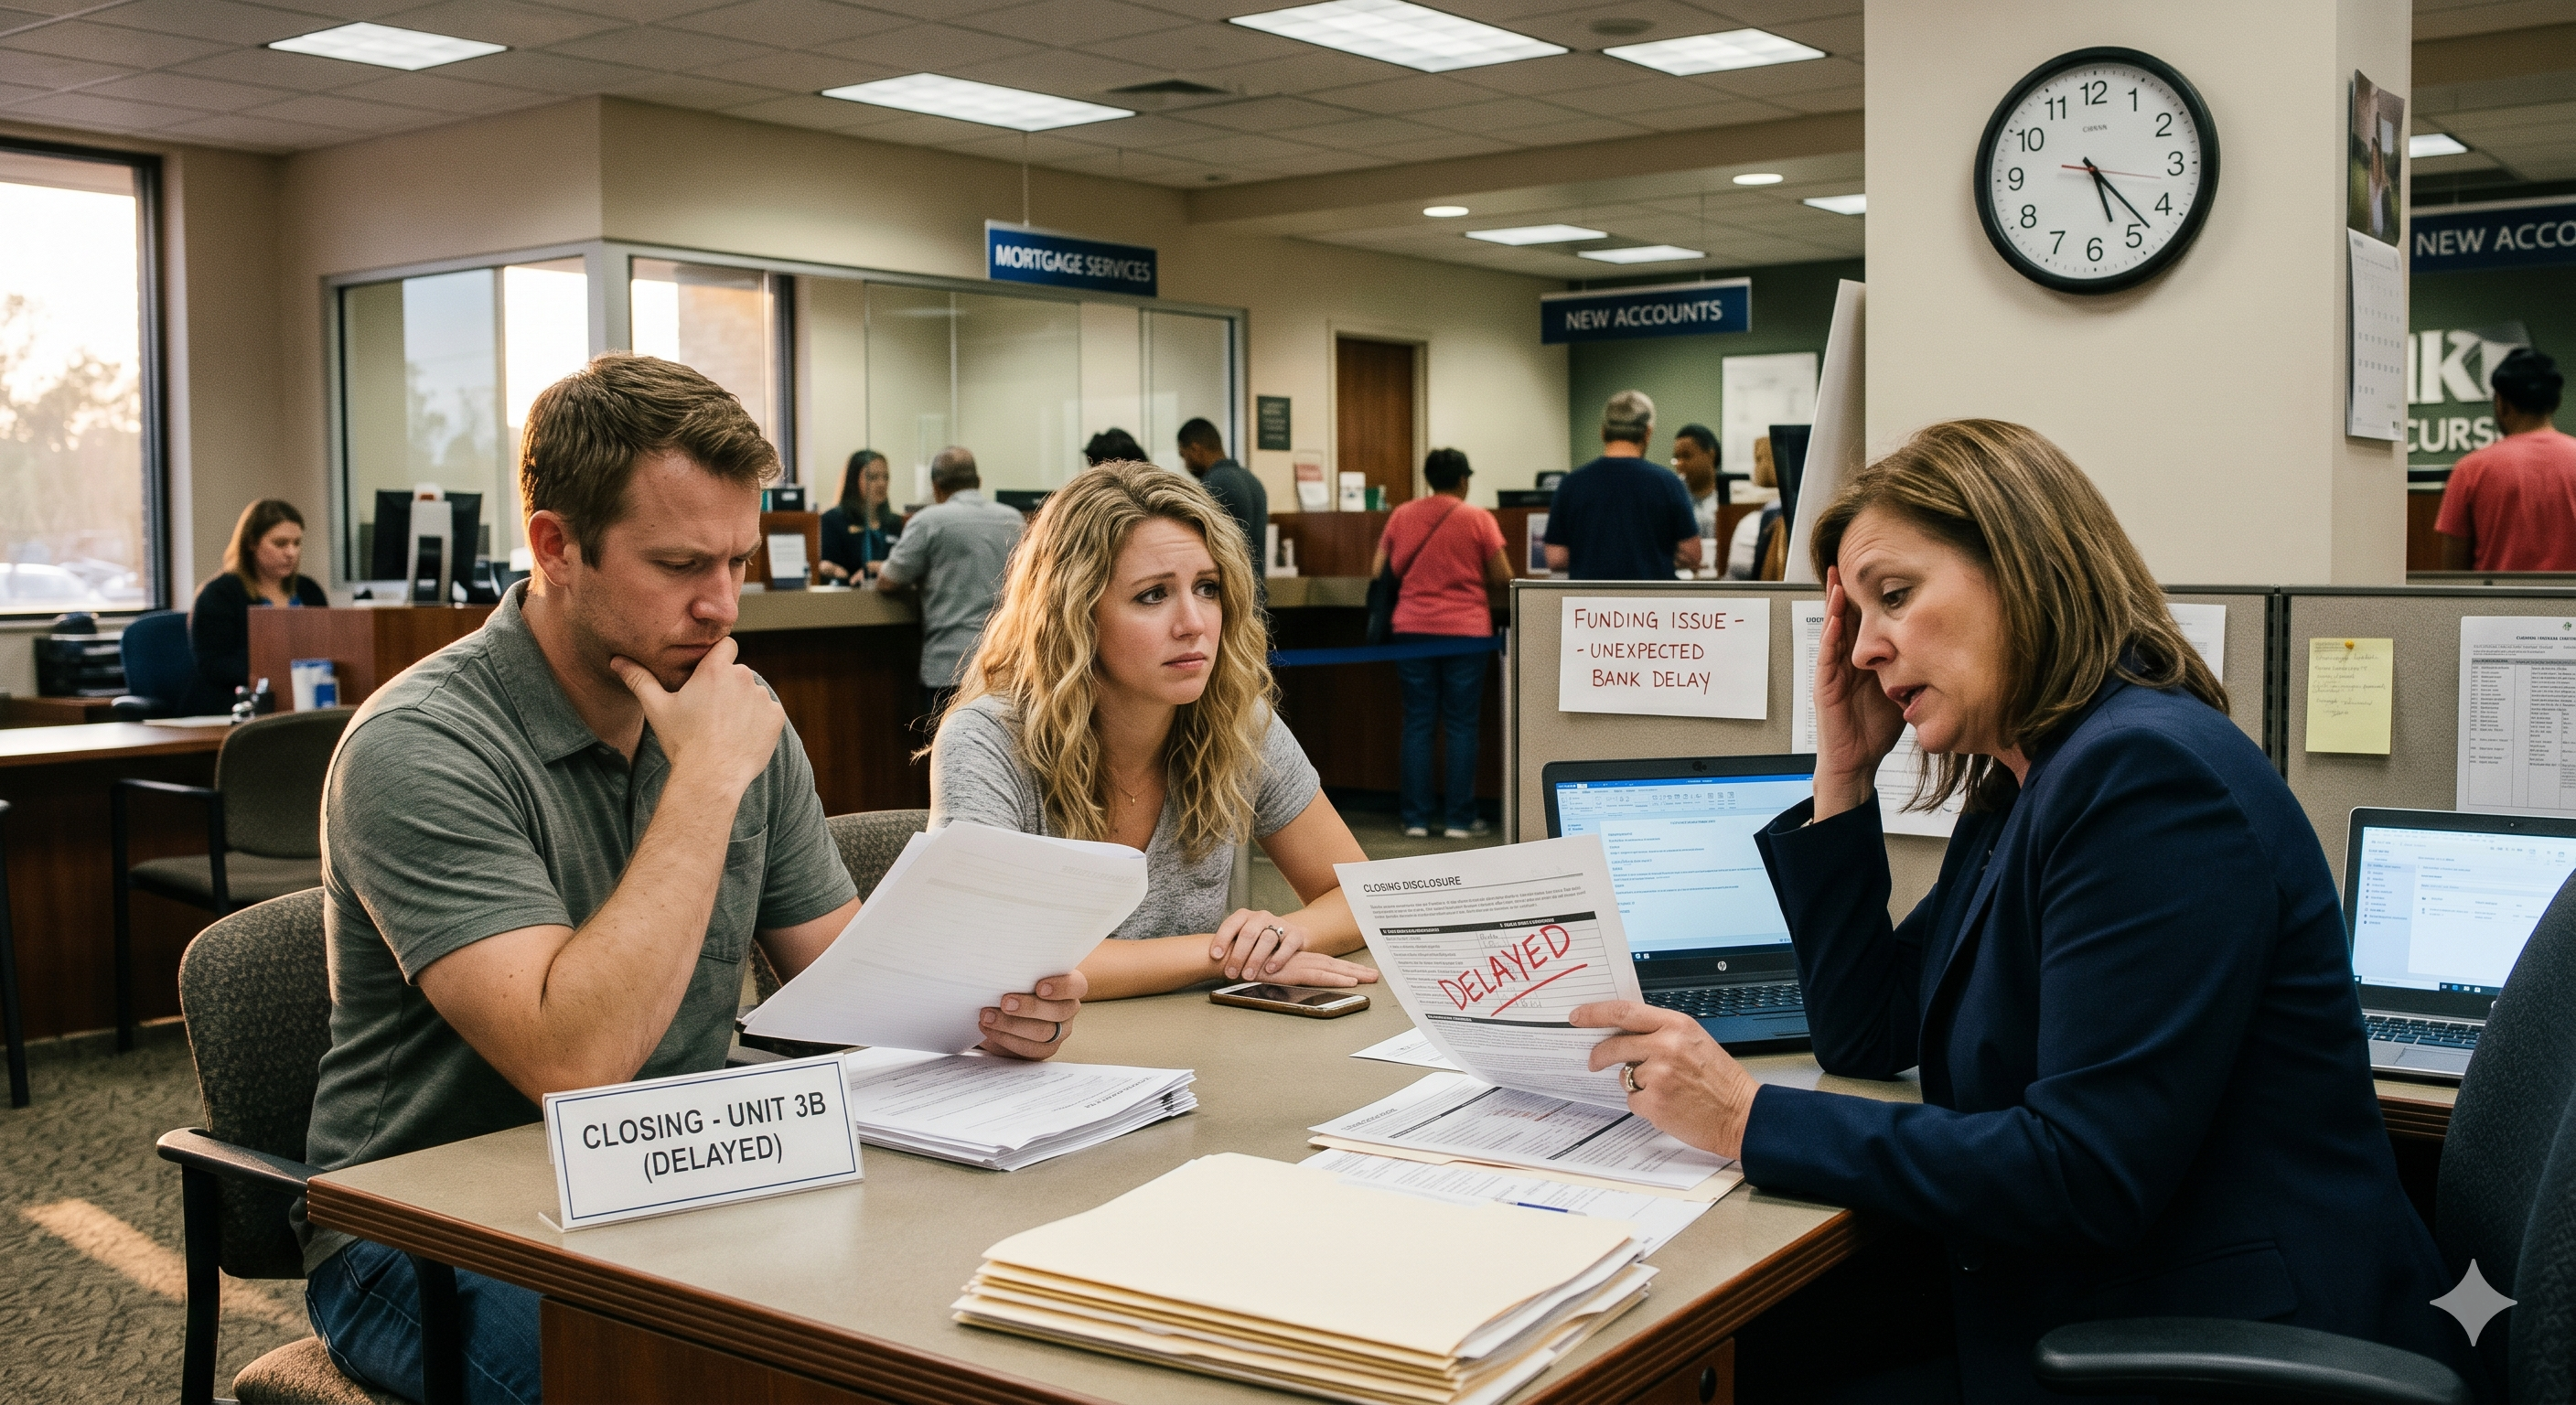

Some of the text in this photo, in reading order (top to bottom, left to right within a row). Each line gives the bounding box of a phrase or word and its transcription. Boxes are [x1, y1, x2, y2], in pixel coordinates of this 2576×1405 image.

[2079, 80, 2108, 106] 12
[2127, 87, 2138, 113] 1
[2045, 95, 2066, 121] 11
[2155, 112, 2173, 138] 2
[2016, 126, 2045, 153] 10
[2166, 150, 2184, 177] 3
[2008, 166, 2024, 191] 9
[2020, 204, 2037, 229] 8
[2154, 191, 2173, 216] 4
[2049, 230, 2066, 255] 7
[2125, 223, 2142, 249] 5
[2415, 227, 2486, 257] NEW
[2086, 236, 2103, 263] 6
[994, 243, 1151, 283] MORTGAGE SERVICES
[1565, 299, 1723, 331] NEW ACCOUNTS
[1574, 608, 1658, 630] FUNDING
[1671, 611, 1727, 629] ISSUE
[1590, 642, 1704, 660] UNEXPECTED
[1593, 669, 1711, 695] BANK DELAY
[1363, 875, 1462, 893] CLOSING DISCLOSURE
[1437, 923, 1571, 1012] DELAYED
[582, 1109, 704, 1150] CLOSING
[727, 1096, 786, 1128] UNIT
[793, 1091, 827, 1119] 3B
[643, 1132, 783, 1185] (DELAYED)
